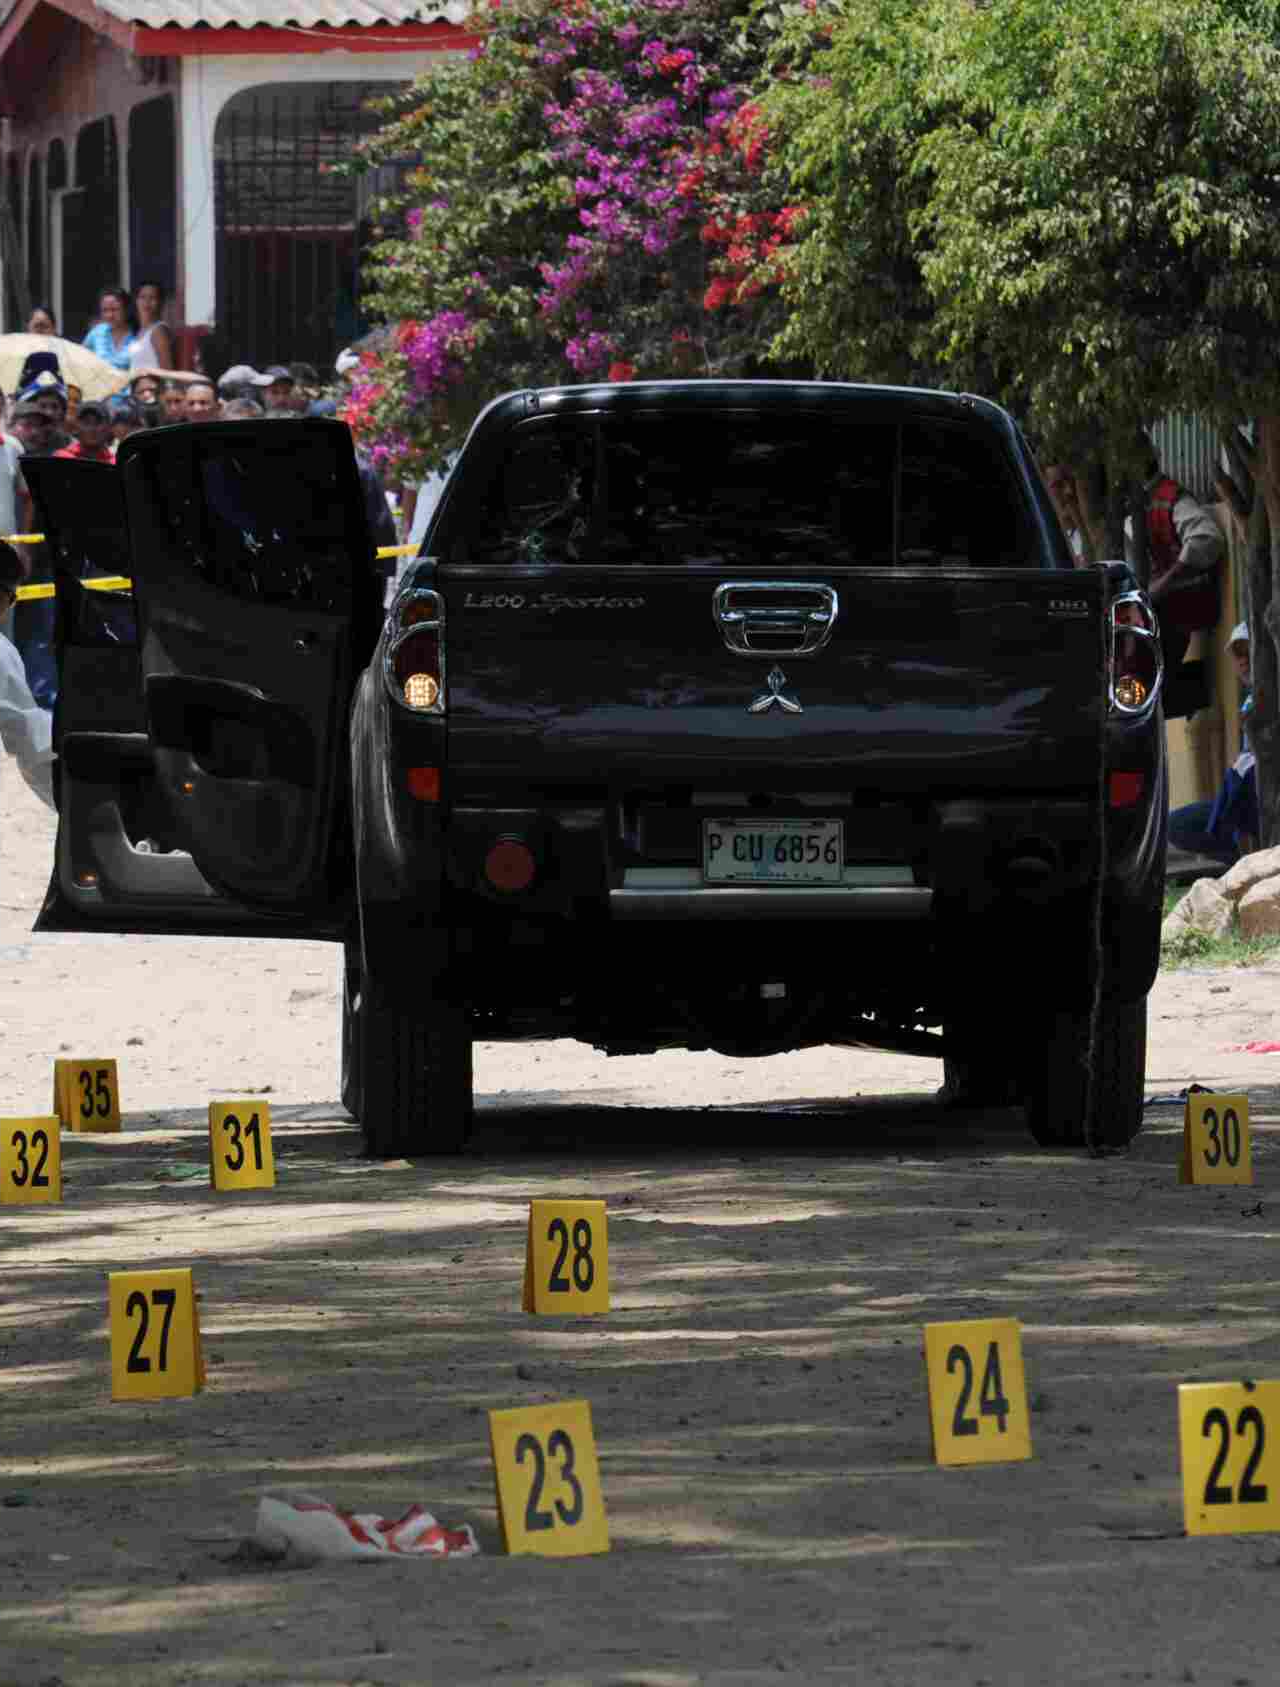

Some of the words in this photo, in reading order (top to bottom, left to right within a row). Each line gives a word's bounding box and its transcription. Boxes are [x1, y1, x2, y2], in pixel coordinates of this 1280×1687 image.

[464, 591, 527, 609] L200
[709, 833, 723, 861] P
[733, 834, 763, 862] CU
[774, 834, 838, 864] 6856
[80, 1069, 113, 1121] 35
[11, 1130, 49, 1188] 32
[223, 1113, 263, 1171] 31
[1203, 1108, 1240, 1168] 30
[547, 1218, 593, 1293] 28
[126, 1289, 177, 1374] 27
[947, 1342, 1010, 1436] 24
[516, 1429, 584, 1532] 23
[1203, 1406, 1269, 1504] 22
